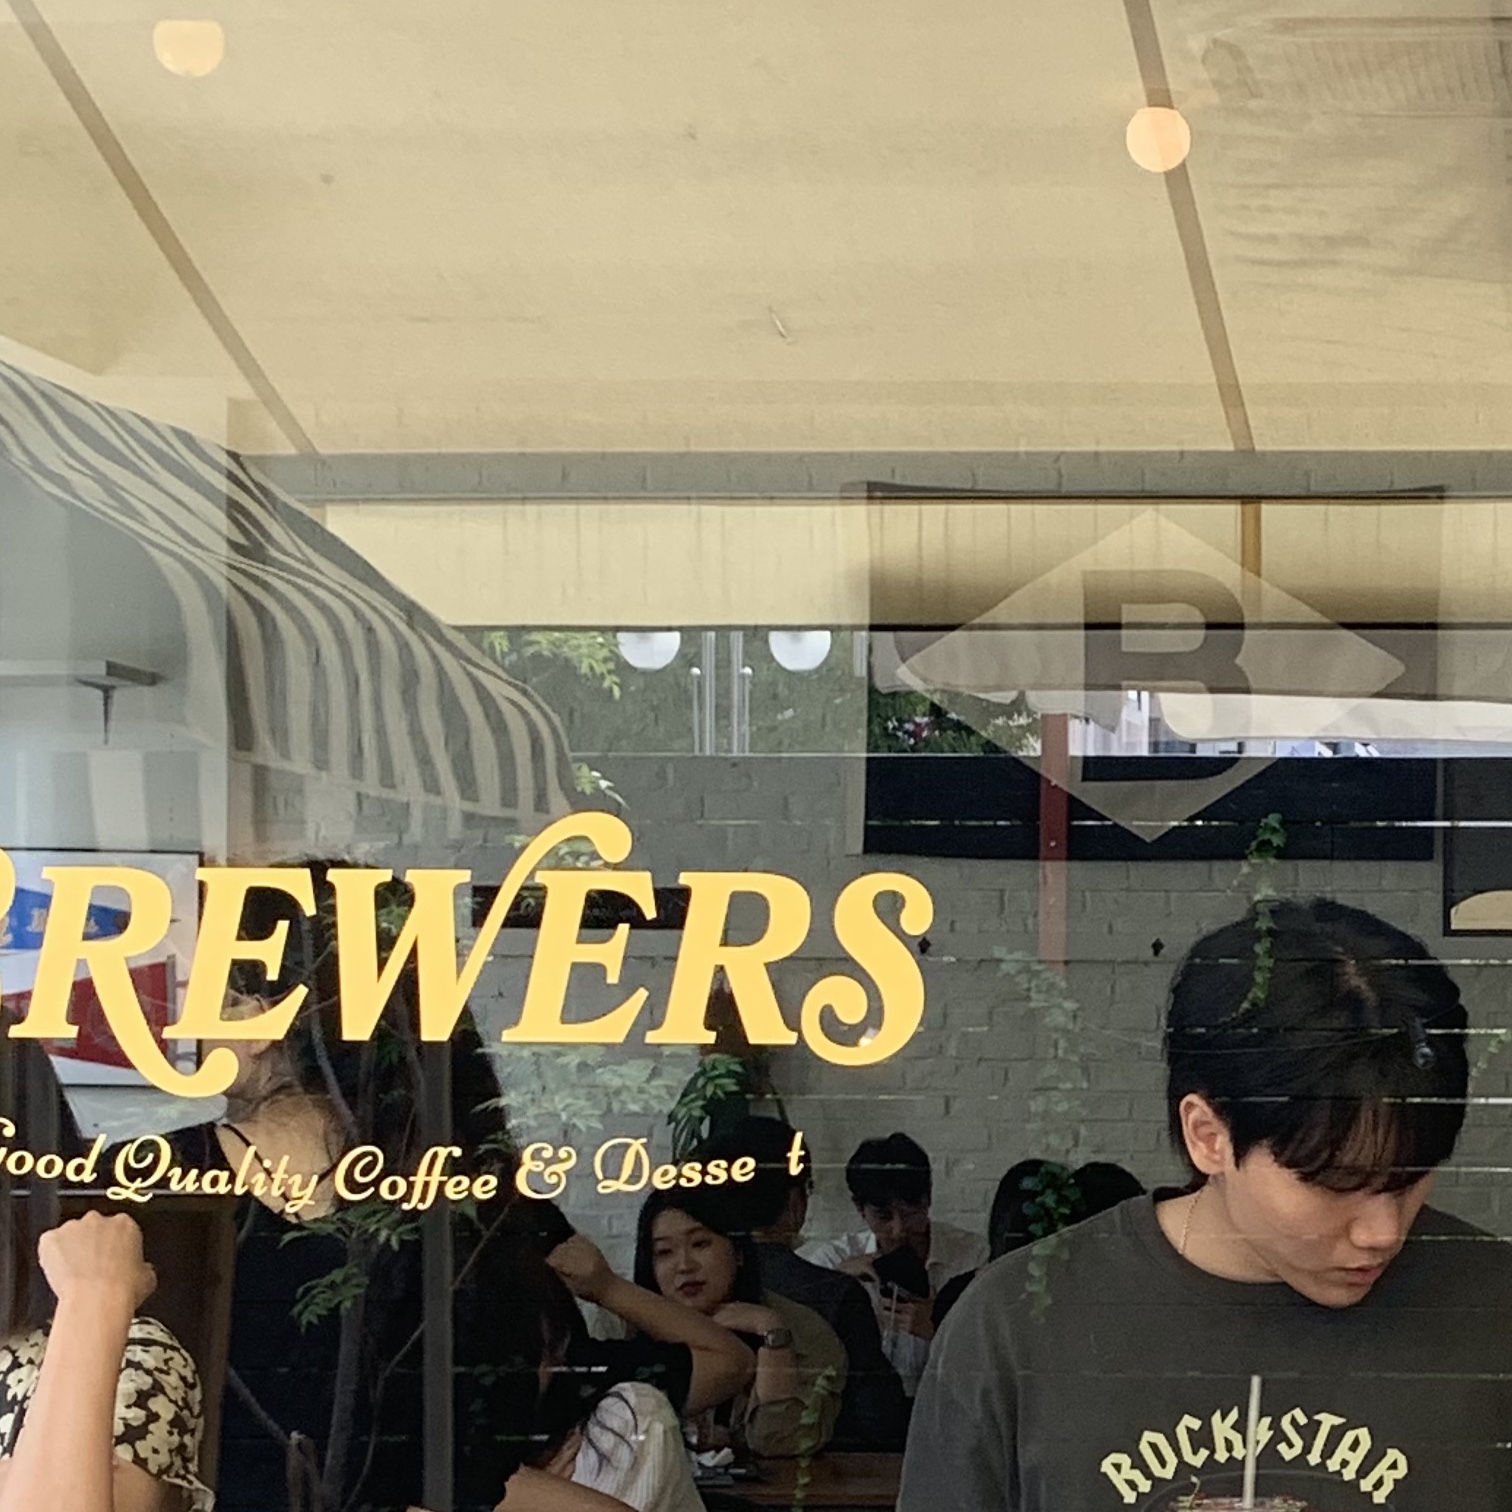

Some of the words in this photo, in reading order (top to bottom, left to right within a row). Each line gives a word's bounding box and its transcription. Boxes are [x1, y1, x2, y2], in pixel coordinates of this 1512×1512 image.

[0, 811, 934, 1098] REWERS
[106, 1134, 317, 1213] Quality
[335, 1145, 497, 1210] Coffee
[515, 1141, 577, 1200] &
